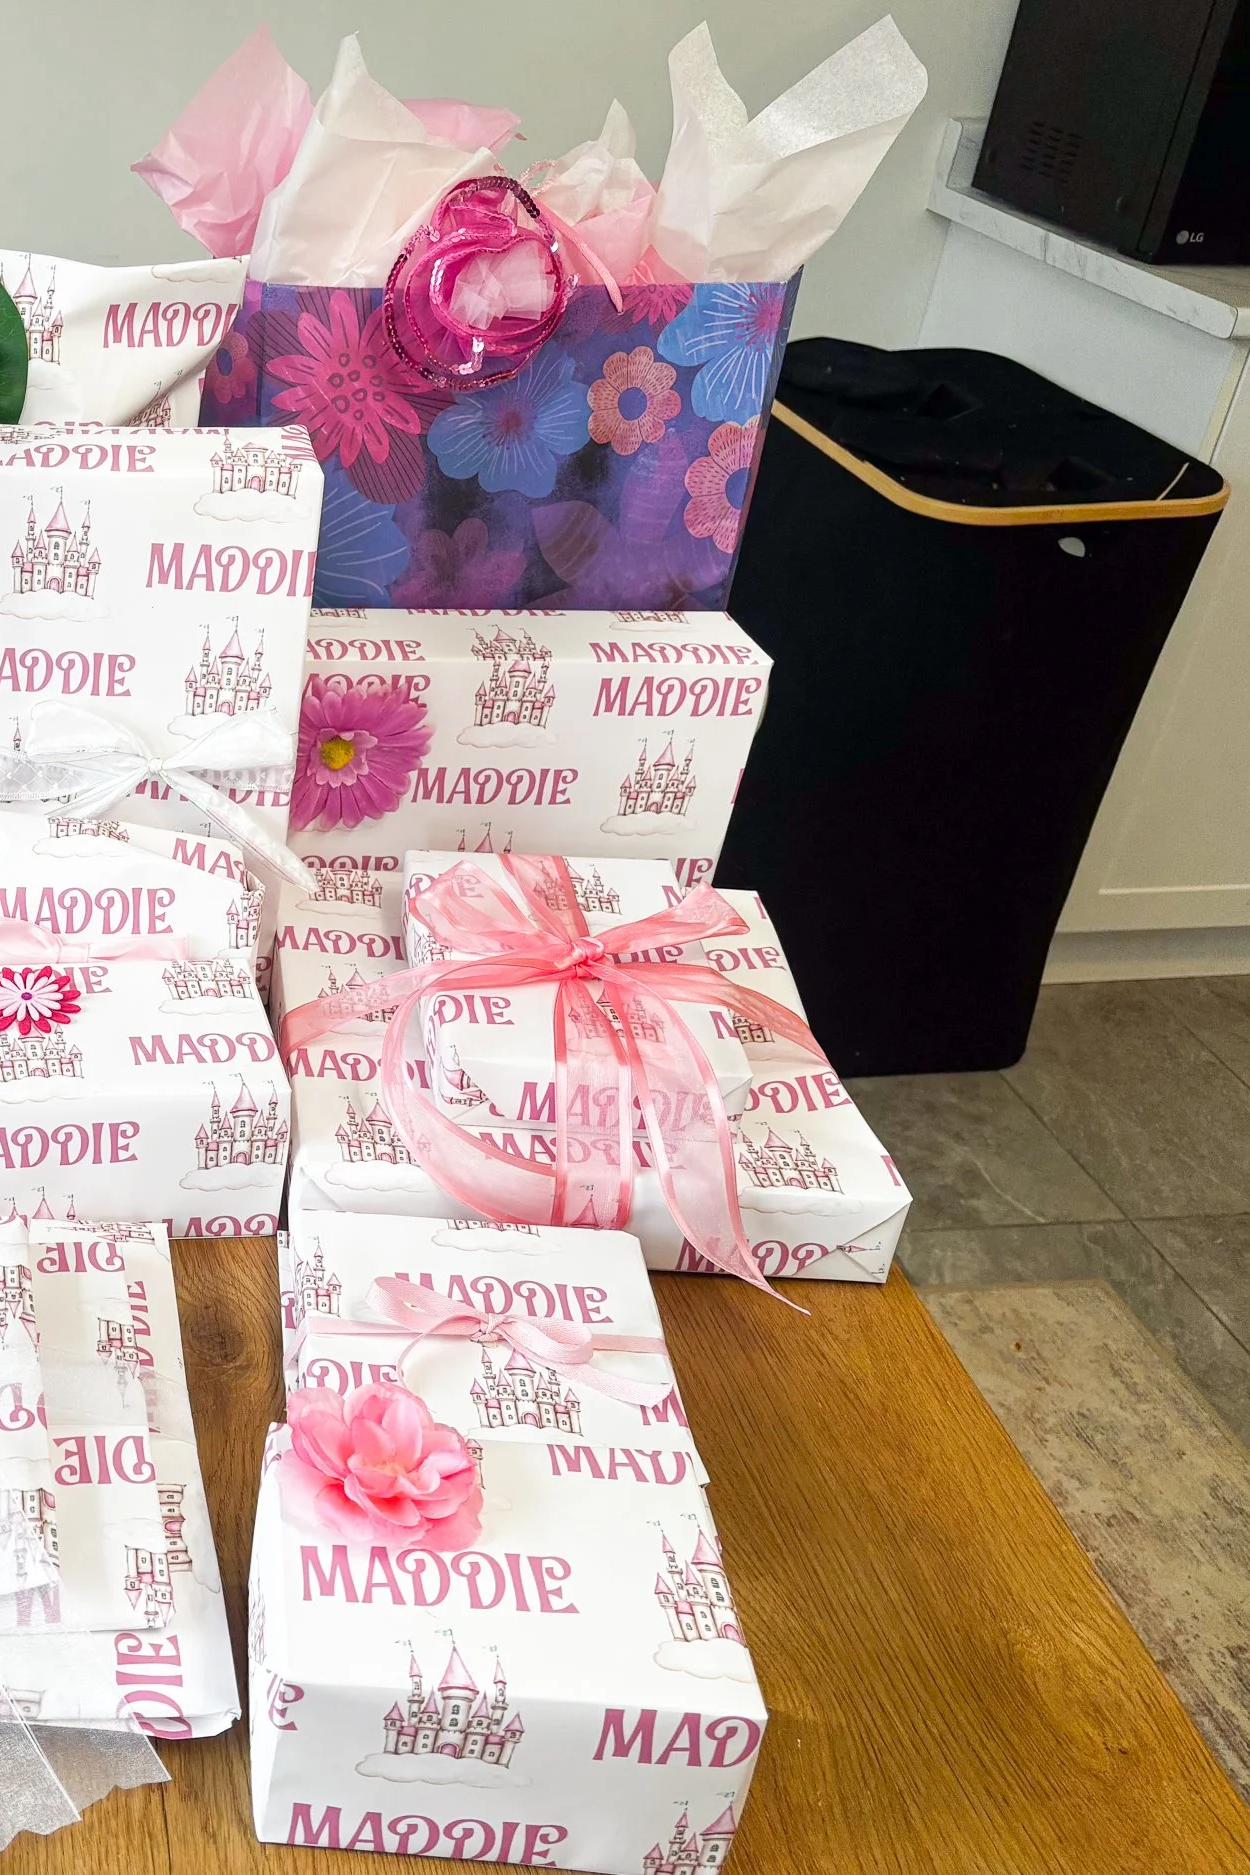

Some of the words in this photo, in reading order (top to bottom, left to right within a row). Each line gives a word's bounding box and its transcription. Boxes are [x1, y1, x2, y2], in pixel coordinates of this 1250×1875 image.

[1190, 232, 1205, 243] LG
[103, 302, 238, 348] MADDI
[306, 638, 426, 661] ADDIE
[589, 642, 759, 665] MADDIE
[593, 676, 762, 717] MADDIE
[411, 767, 579, 806] MADDIE
[706, 947, 786, 972] DIE
[433, 994, 515, 1027] DIE
[129, 1032, 275, 1065] MADD
[53, 1436, 156, 1486] DIE
[300, 1545, 580, 1614] MADDIE
[114, 1631, 193, 1739] DIE
[593, 1708, 761, 1768] MAD
[287, 1802, 568, 1867] MADDIE
